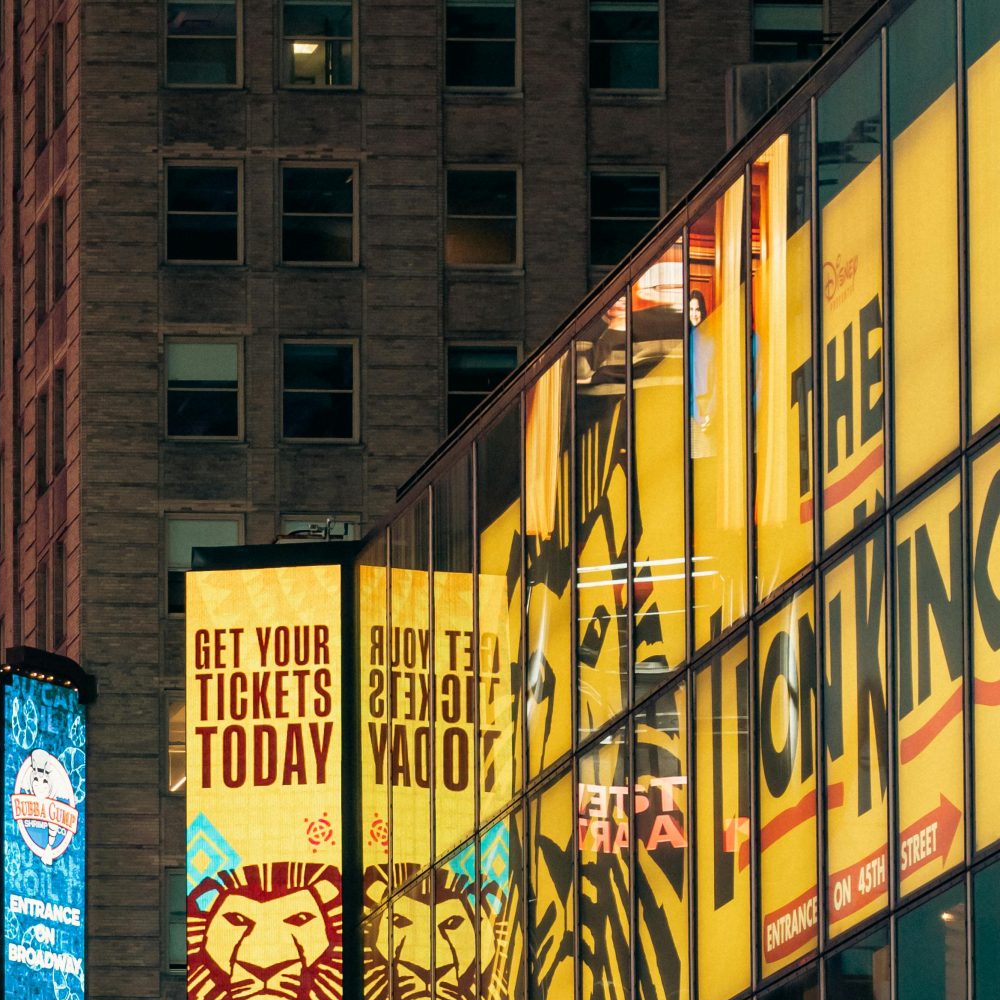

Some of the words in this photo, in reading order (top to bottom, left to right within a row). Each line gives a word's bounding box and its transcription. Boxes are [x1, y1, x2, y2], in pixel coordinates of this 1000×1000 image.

[791, 293, 884, 499] THE
[194, 628, 244, 671] GET
[256, 625, 330, 668] YOUR
[195, 669, 331, 721] TICKETS
[195, 721, 334, 789] TODAY
[14, 798, 46, 818] BUBBA
[48, 801, 76, 828] GUMP
[766, 896, 818, 953] ENTRANCE
[833, 875, 852, 911] ON
[858, 854, 886, 895] 45TH
[901, 820, 938, 871] STREET
[9, 893, 81, 927] ENTRANCE
[34, 923, 55, 946] ON
[8, 942, 83, 975] BROADWAY
